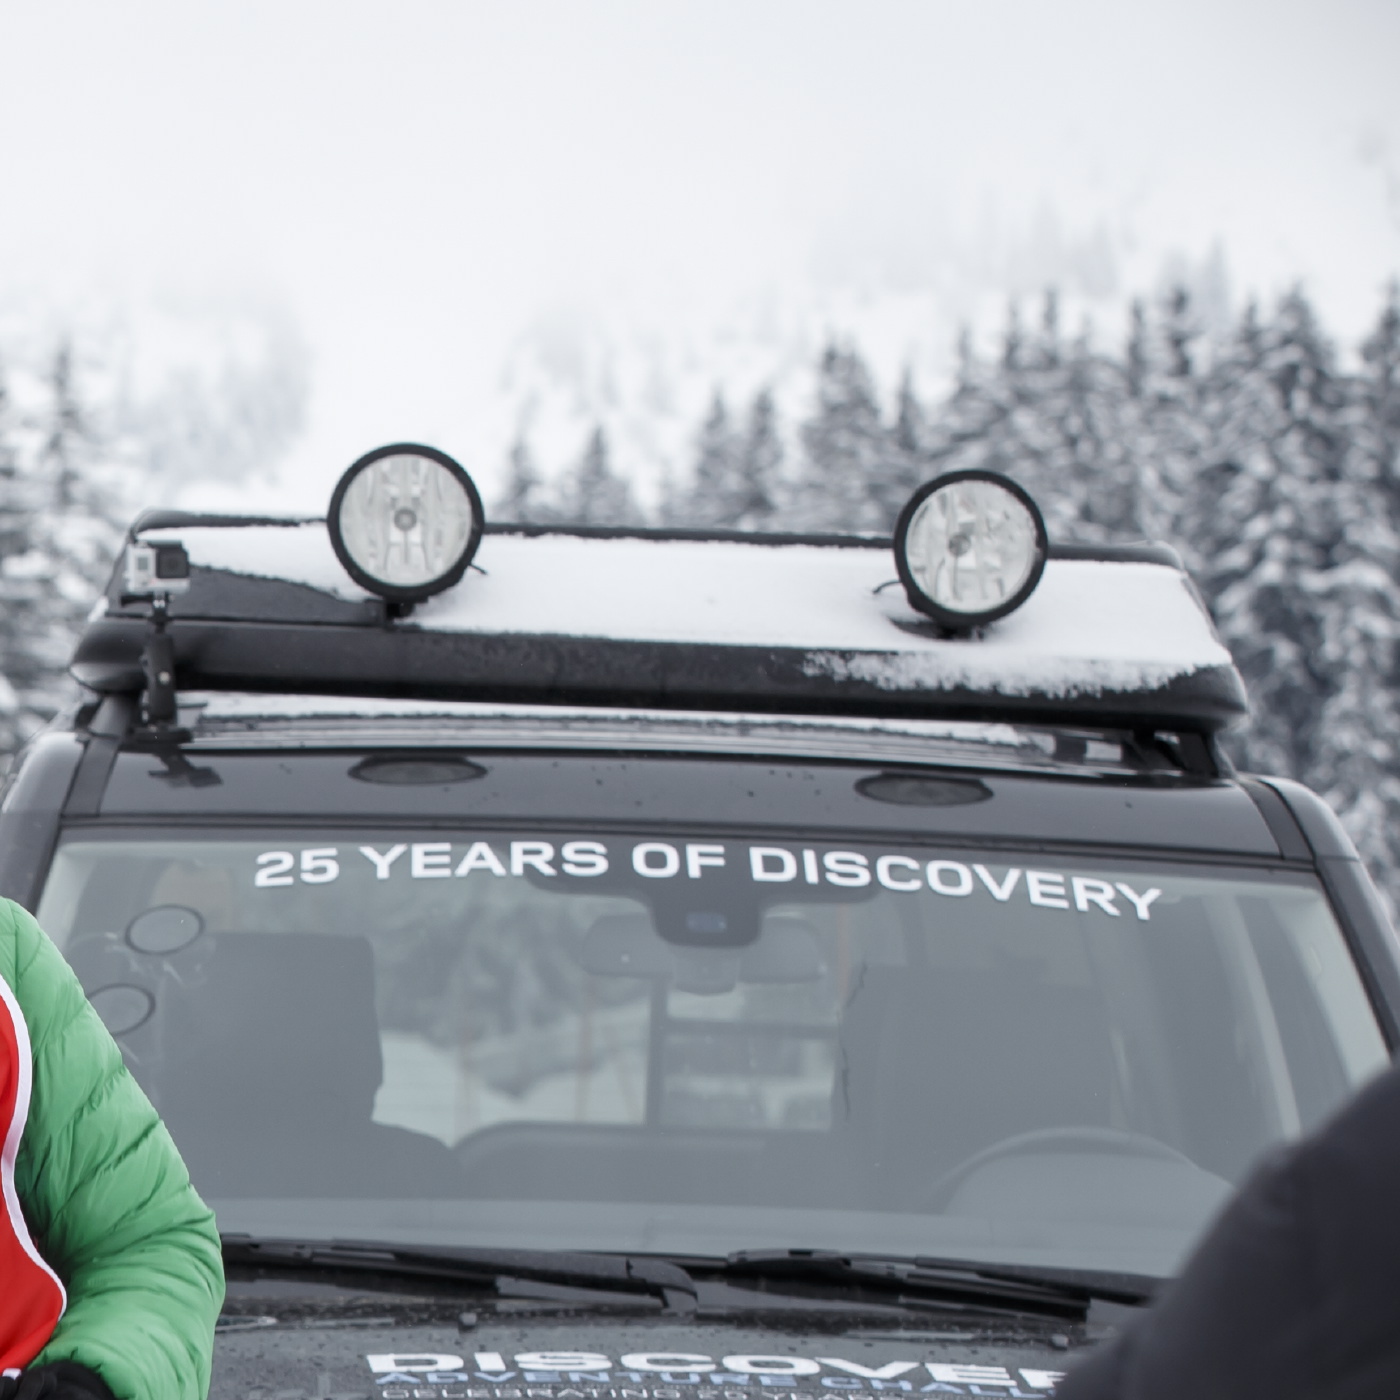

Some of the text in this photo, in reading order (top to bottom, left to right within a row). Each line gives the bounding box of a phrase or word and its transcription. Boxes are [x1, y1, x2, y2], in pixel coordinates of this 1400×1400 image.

[255, 841, 1162, 921] 25 YEARS OF DISCOVERY
[375, 1371, 1056, 1399] ADVENTURE CHALL
